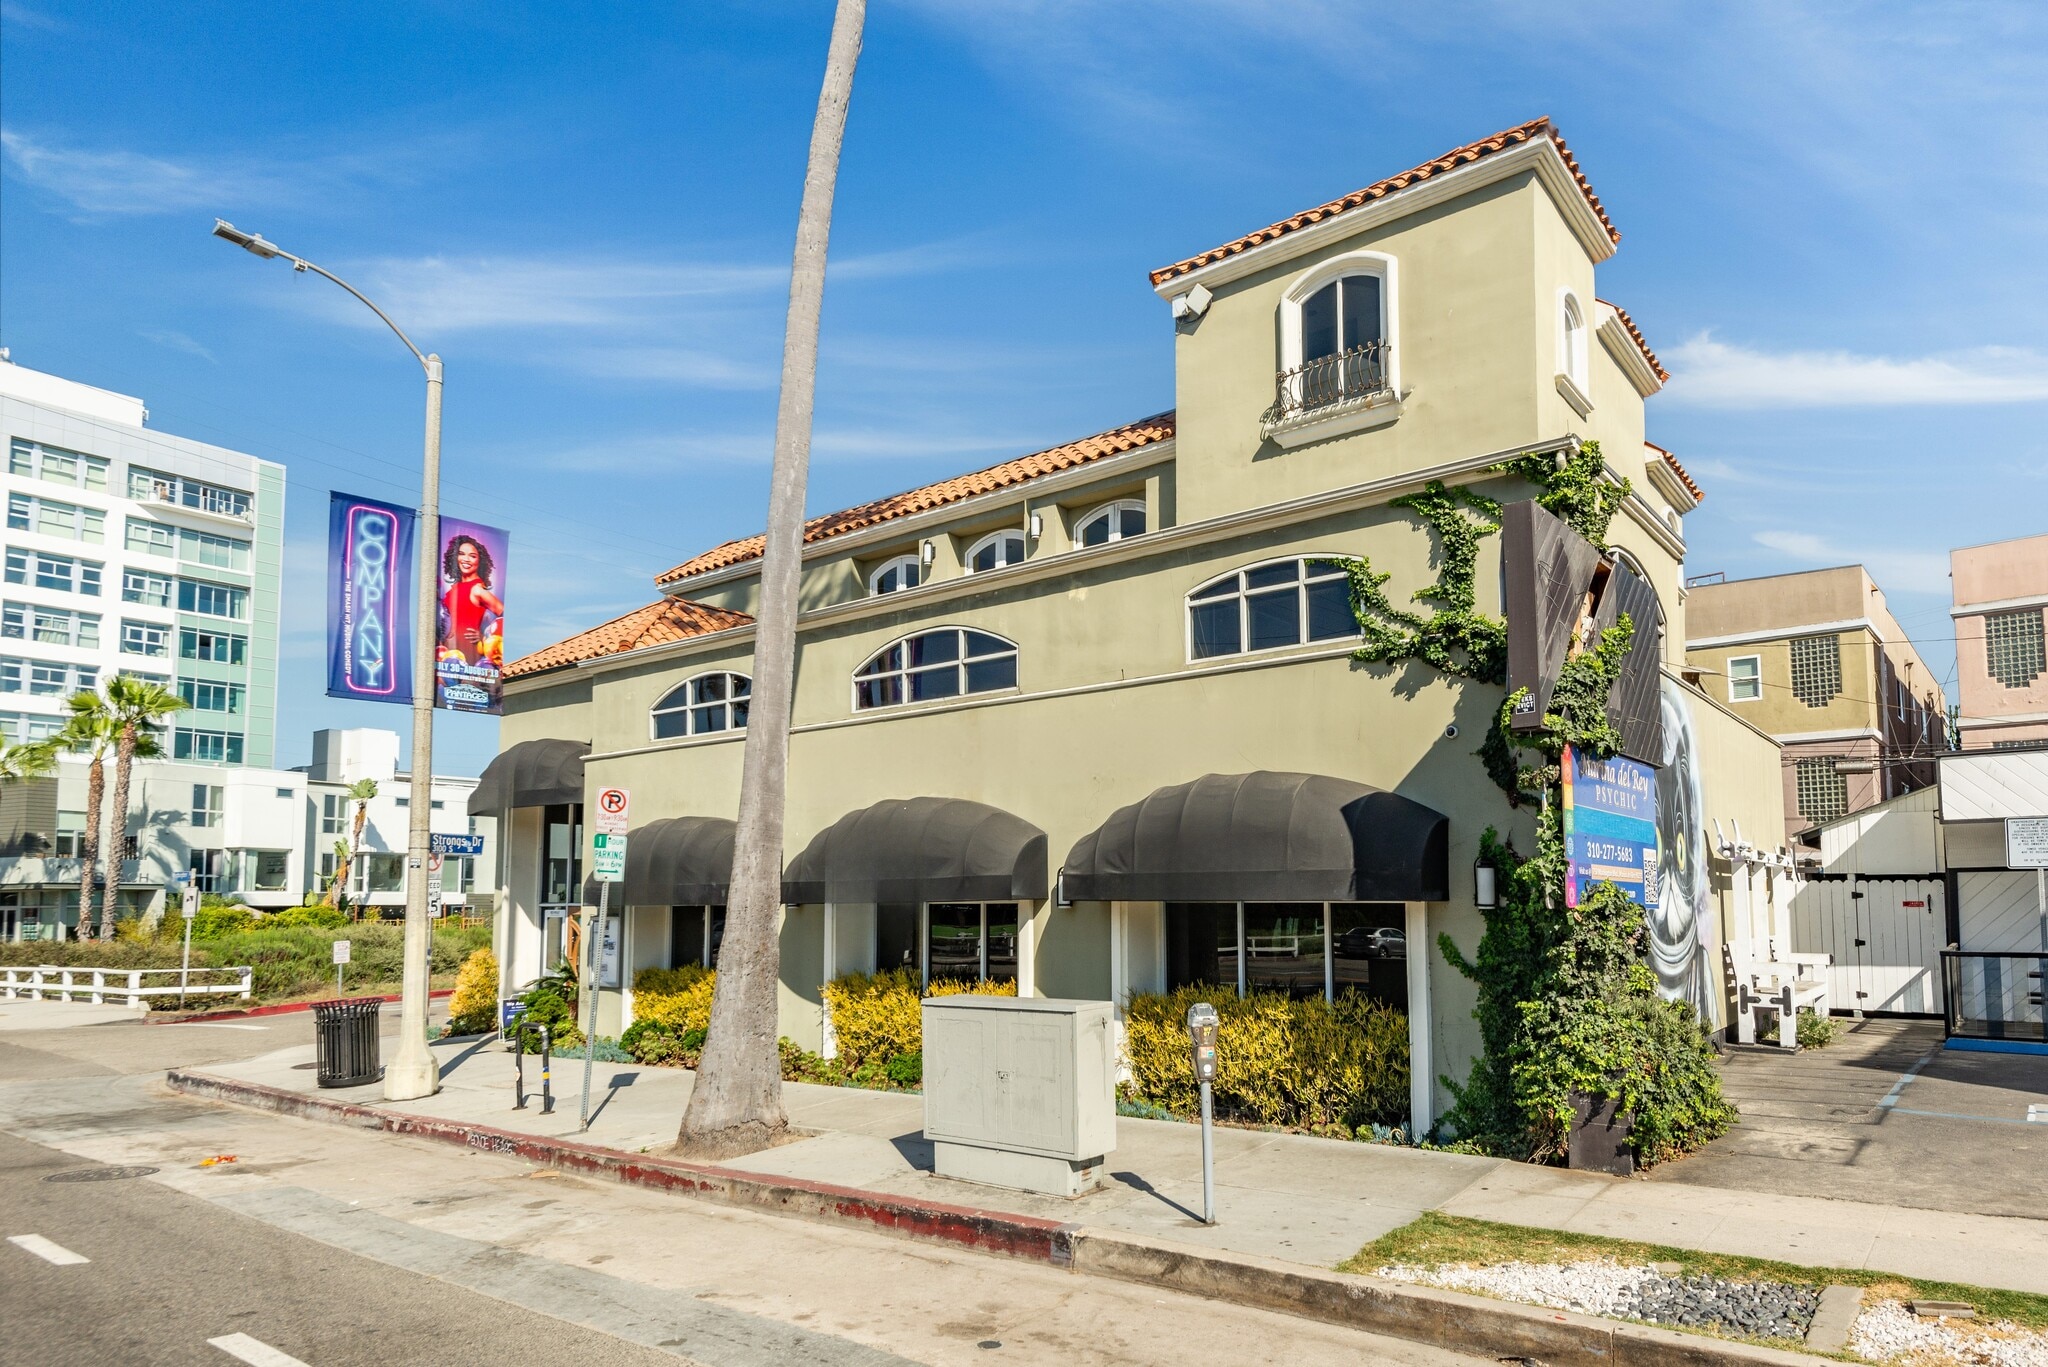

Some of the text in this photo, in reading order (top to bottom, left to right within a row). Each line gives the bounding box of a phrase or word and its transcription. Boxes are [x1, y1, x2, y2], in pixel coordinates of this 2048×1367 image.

[357, 514, 387, 688] COMPANY
[344, 650, 352, 675] COMEDY
[1618, 762, 1633, 789] del
[1632, 769, 1649, 801] Rey
[1595, 784, 1637, 811] PSYCHIC
[472, 836, 482, 847] Dr
[1587, 841, 1634, 863] 310-277-5683
[595, 850, 624, 860] PARKING
